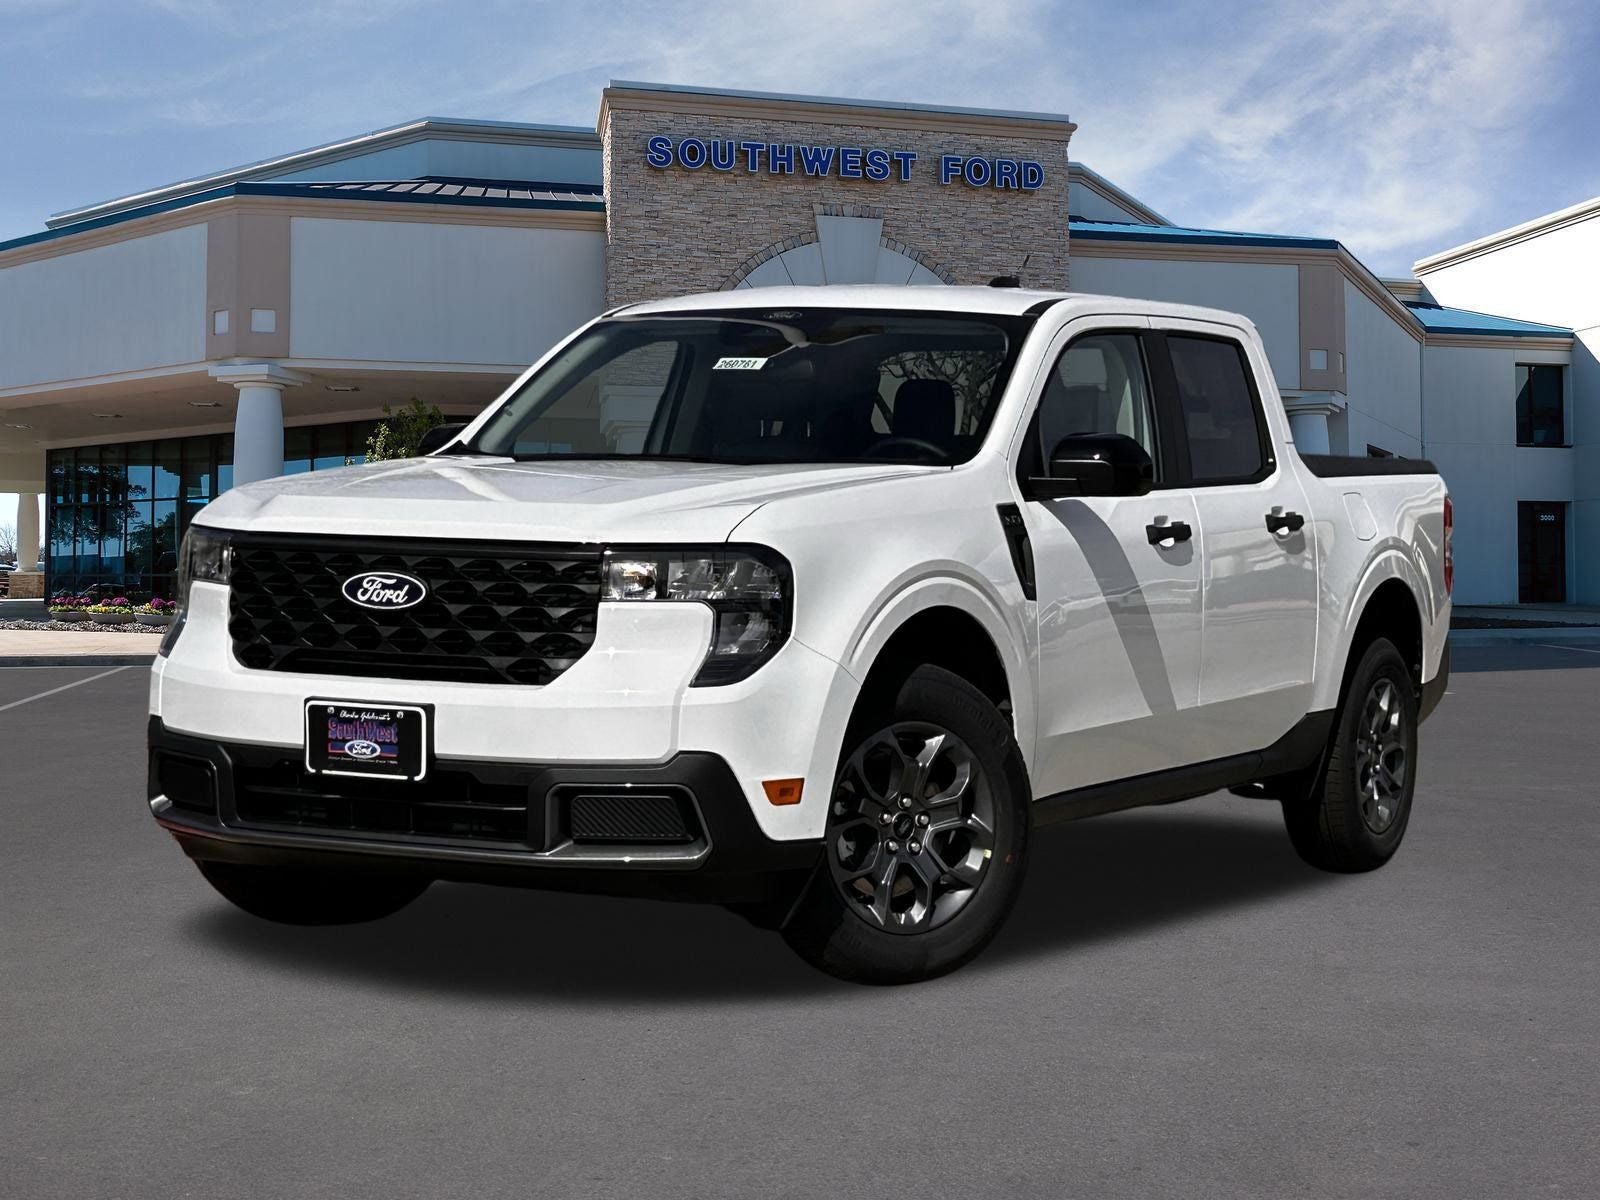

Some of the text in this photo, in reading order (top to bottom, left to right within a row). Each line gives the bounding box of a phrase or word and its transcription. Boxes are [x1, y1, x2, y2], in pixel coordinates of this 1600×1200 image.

[646, 135, 1045, 190] SOUTHWEST FORD
[357, 576, 409, 603] Ford
